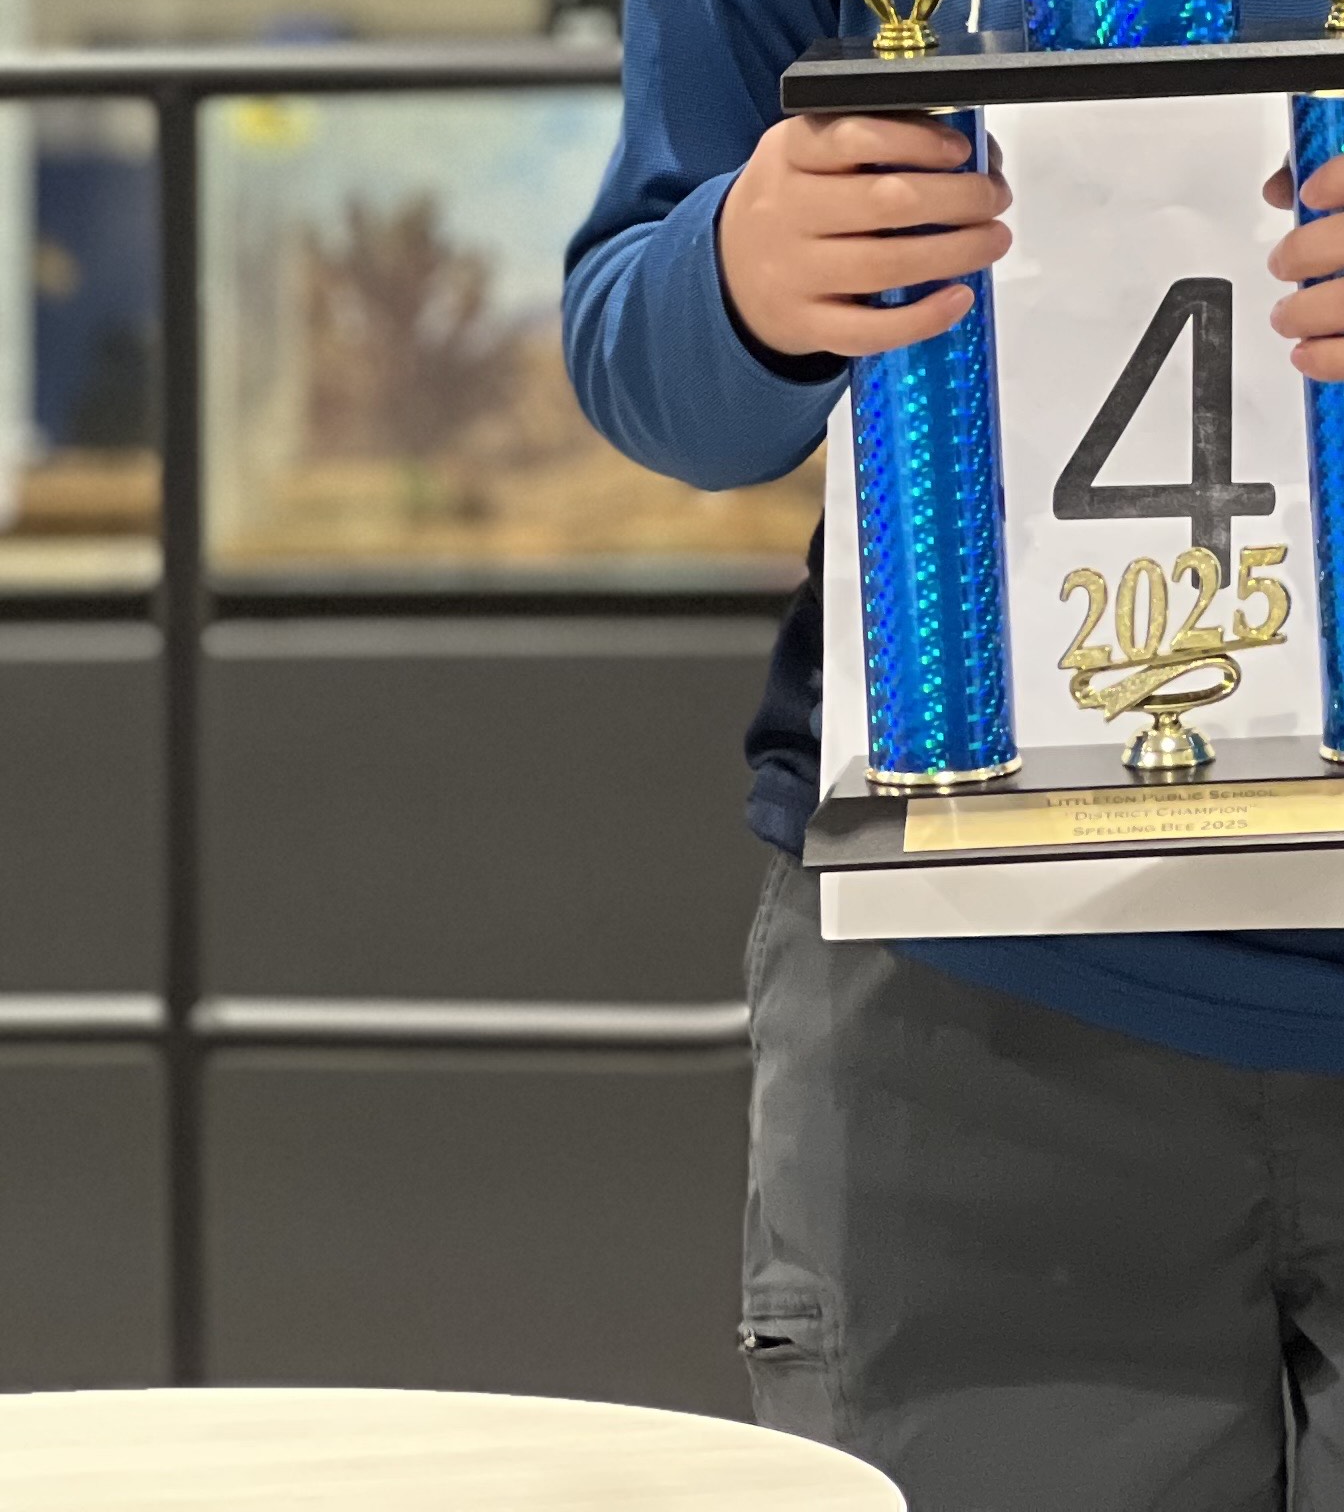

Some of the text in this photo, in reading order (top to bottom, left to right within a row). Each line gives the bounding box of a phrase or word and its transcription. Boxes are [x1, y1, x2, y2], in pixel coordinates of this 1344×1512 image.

[1053, 277, 1275, 589] 4
[1058, 545, 1291, 670] 2025
[1073, 819, 1248, 837] SPELLING BEE 2025
[1142, 791, 1202, 803] PUBLIC
